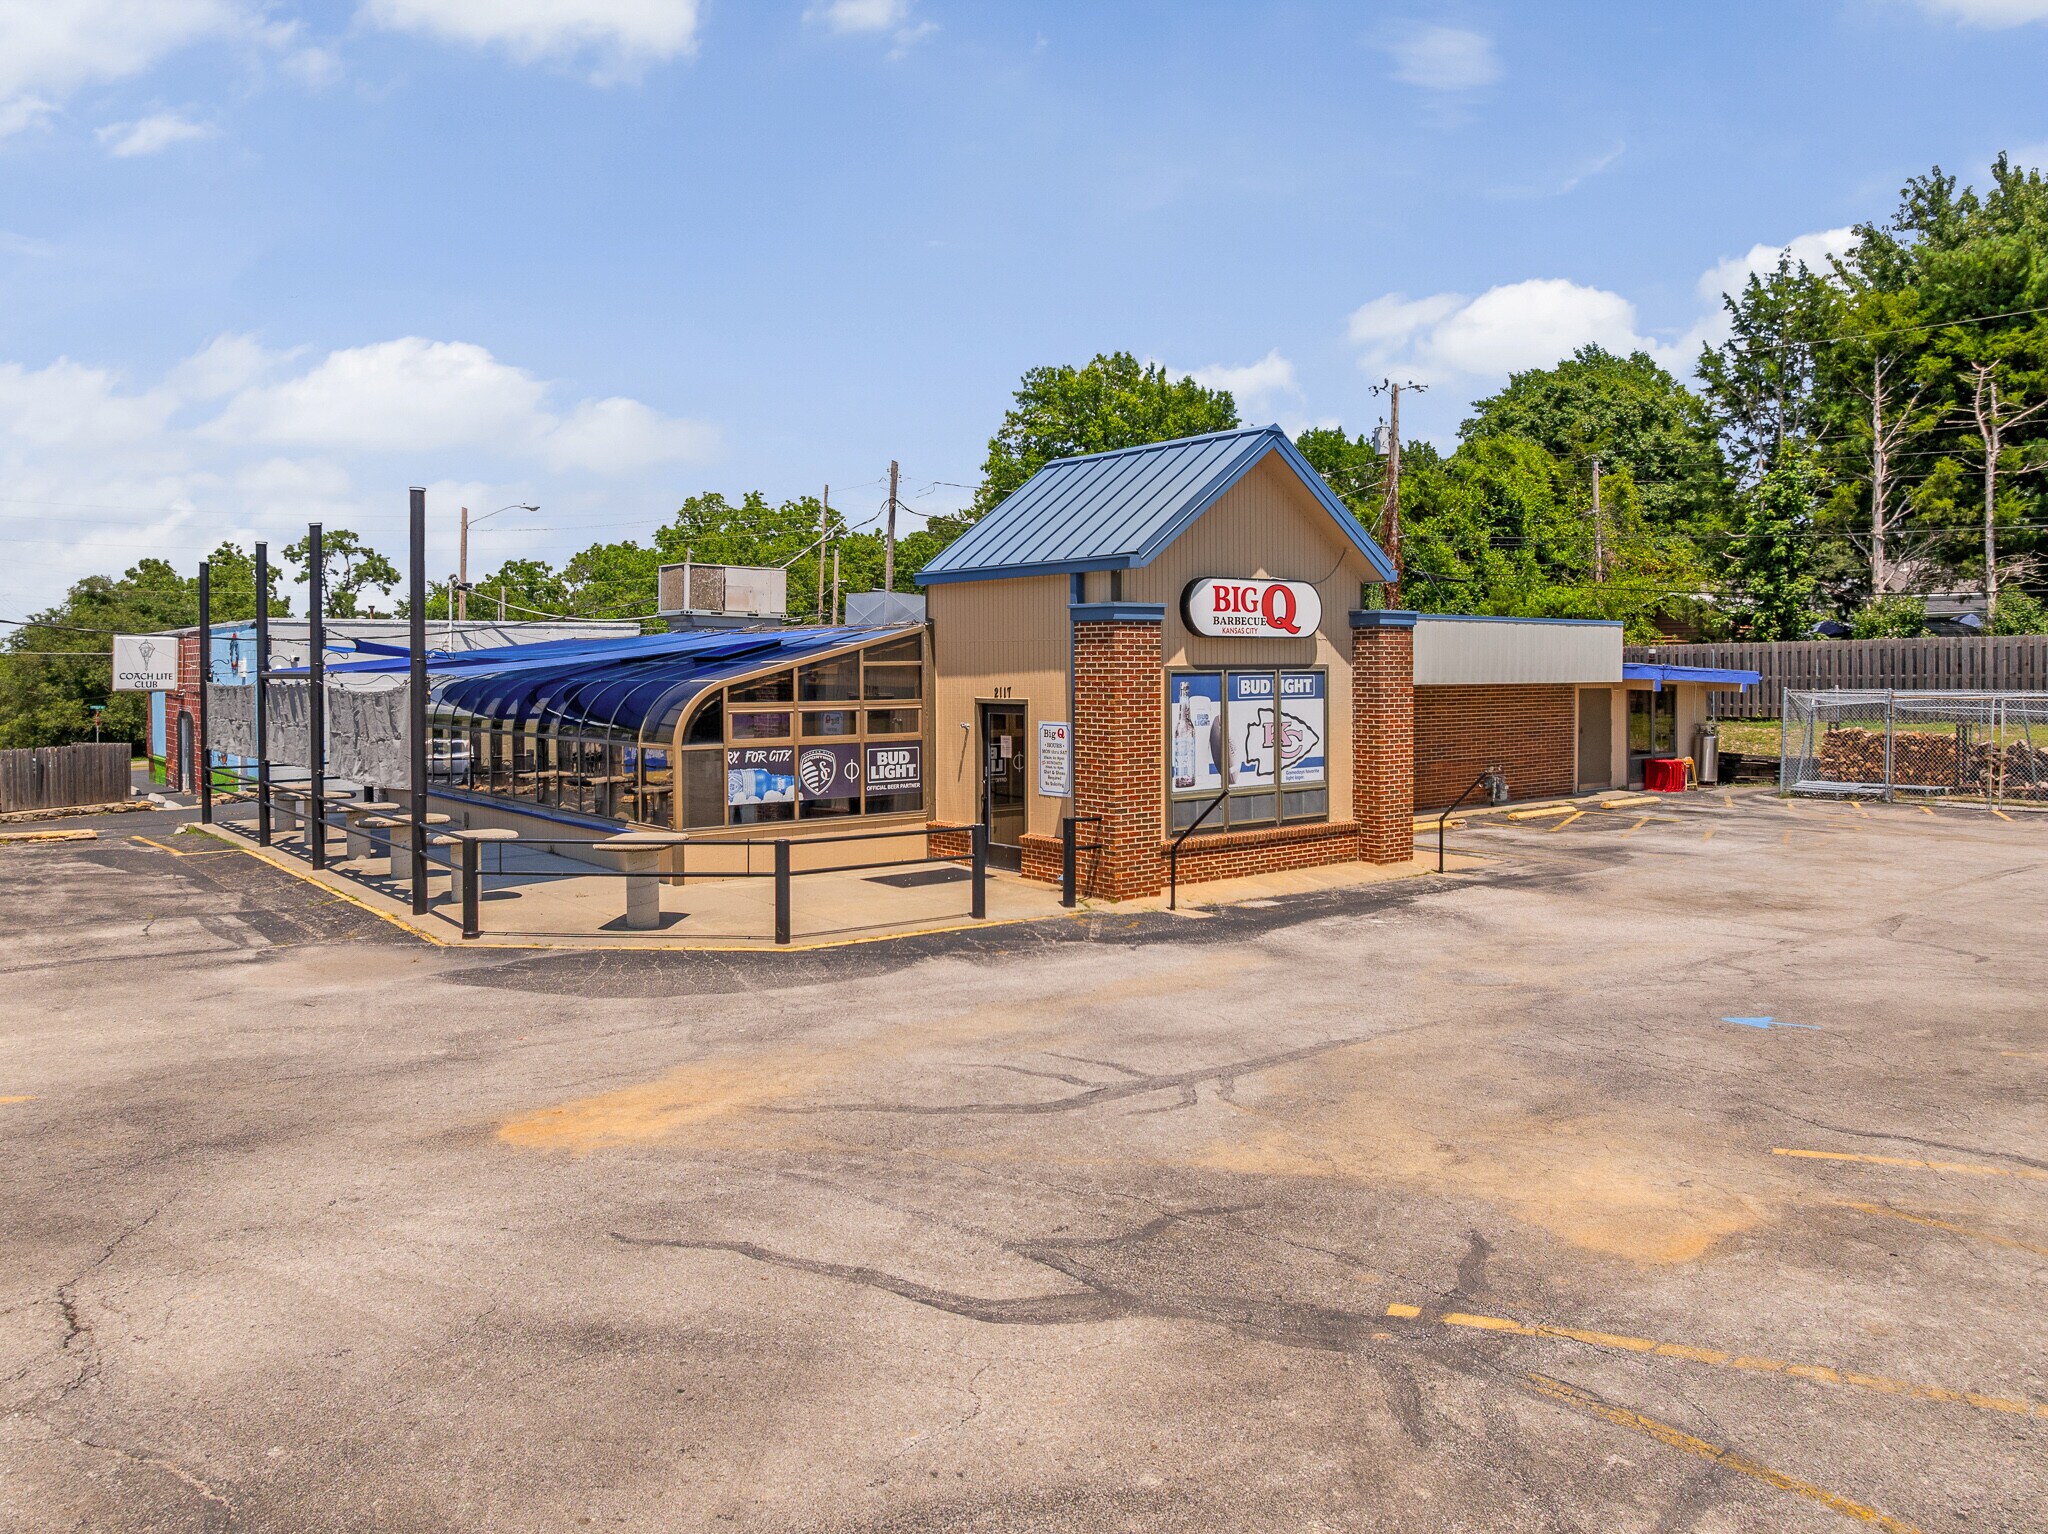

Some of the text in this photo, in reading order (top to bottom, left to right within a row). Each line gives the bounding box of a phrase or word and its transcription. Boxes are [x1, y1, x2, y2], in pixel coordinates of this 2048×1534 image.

[1213, 584, 1301, 634] BIG Q
[1213, 616, 1267, 626] BARBECUE
[1222, 627, 1259, 635] KANSAS CITY
[119, 672, 153, 680] COACH
[994, 687, 1012, 698] 2117
[1240, 679, 1313, 695] BUD IGHT
[1044, 728, 1065, 740] Big Q
[744, 750, 768, 764] FOR
[769, 749, 792, 762] CITY.
[877, 751, 910, 766] BUD
[871, 763, 917, 780] LIGHT
